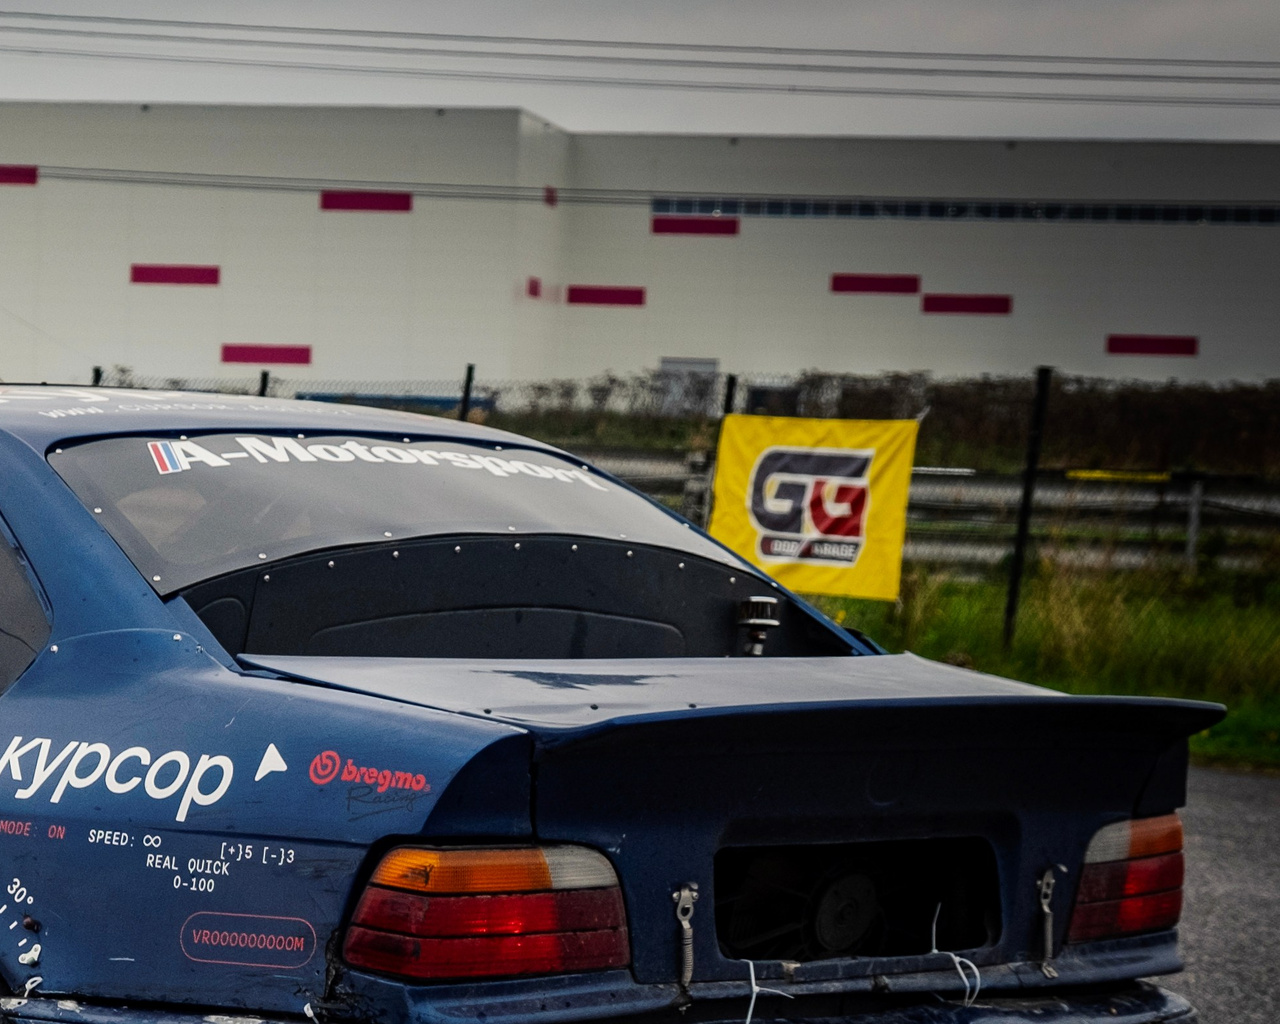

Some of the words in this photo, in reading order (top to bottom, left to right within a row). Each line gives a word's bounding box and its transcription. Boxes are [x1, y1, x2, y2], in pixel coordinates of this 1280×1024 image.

[178, 436, 610, 492] A-Motorsport
[340, 759, 426, 793] bregmo
[47, 824, 66, 840] ON
[87, 829, 136, 848] SPEED:
[146, 853, 179, 871] REAL
[187, 858, 230, 877] QUICK
[172, 875, 215, 893] 0-100
